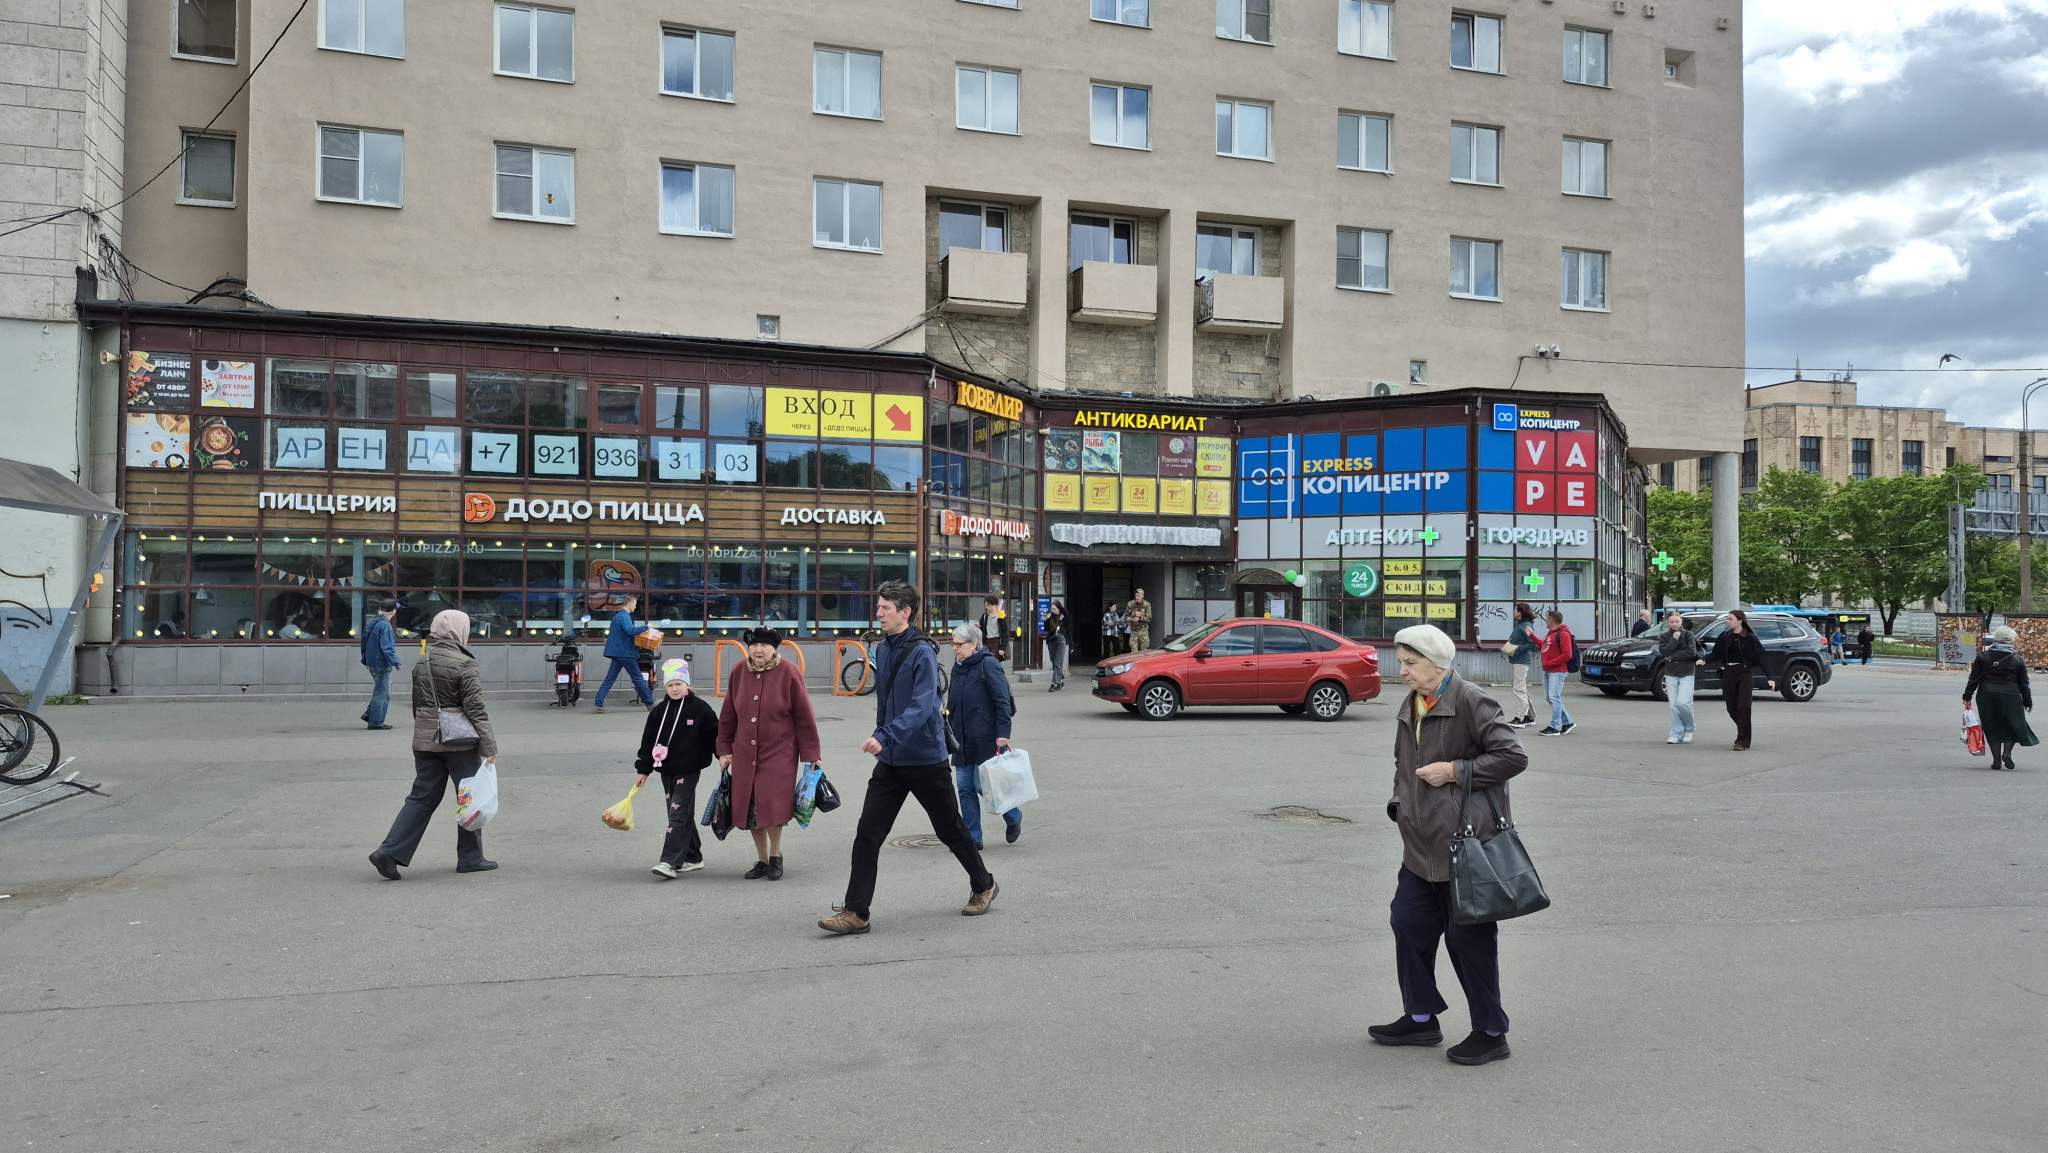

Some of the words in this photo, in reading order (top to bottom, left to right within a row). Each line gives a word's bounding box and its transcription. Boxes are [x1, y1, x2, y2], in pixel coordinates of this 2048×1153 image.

[155, 360, 191, 369] БИЗНЕС
[160, 369, 186, 378] ЛАНЧ
[218, 373, 253, 381] ЗАВТРАК
[784, 396, 855, 420] ВХОД
[957, 381, 1024, 420] ЮВЕЛИР
[1074, 410, 1207, 431] АНТИКВАРИАТ
[1520, 410, 1550, 418] EXPRESS
[1520, 419, 1580, 430] КОПИЦЕНТР
[478, 442, 511, 464] +7
[538, 446, 577, 464] 921
[597, 448, 636, 467] 936
[669, 453, 693, 470] 31
[724, 454, 748, 472] 03
[1303, 457, 1373, 473] EXPRESS
[1303, 472, 1450, 494] КОПИЦЕНТР
[259, 492, 397, 516] ПИЦЦЕРИЯ
[503, 498, 593, 524] ДОДО
[599, 501, 705, 526] ПИЦЦА
[780, 507, 886, 526] ДОСТАВКА
[959, 515, 992, 537] ДОДО
[994, 519, 1031, 541] ПИЦЦА
[1325, 527, 1413, 546] АПТЕКИ
[1486, 527, 1589, 547] ГОРЗДРАВ
[381, 543, 484, 555] DODOPIZZA.RU
[687, 547, 777, 560] DODOPIZZA.RU
[1351, 571, 1368, 583] 24
